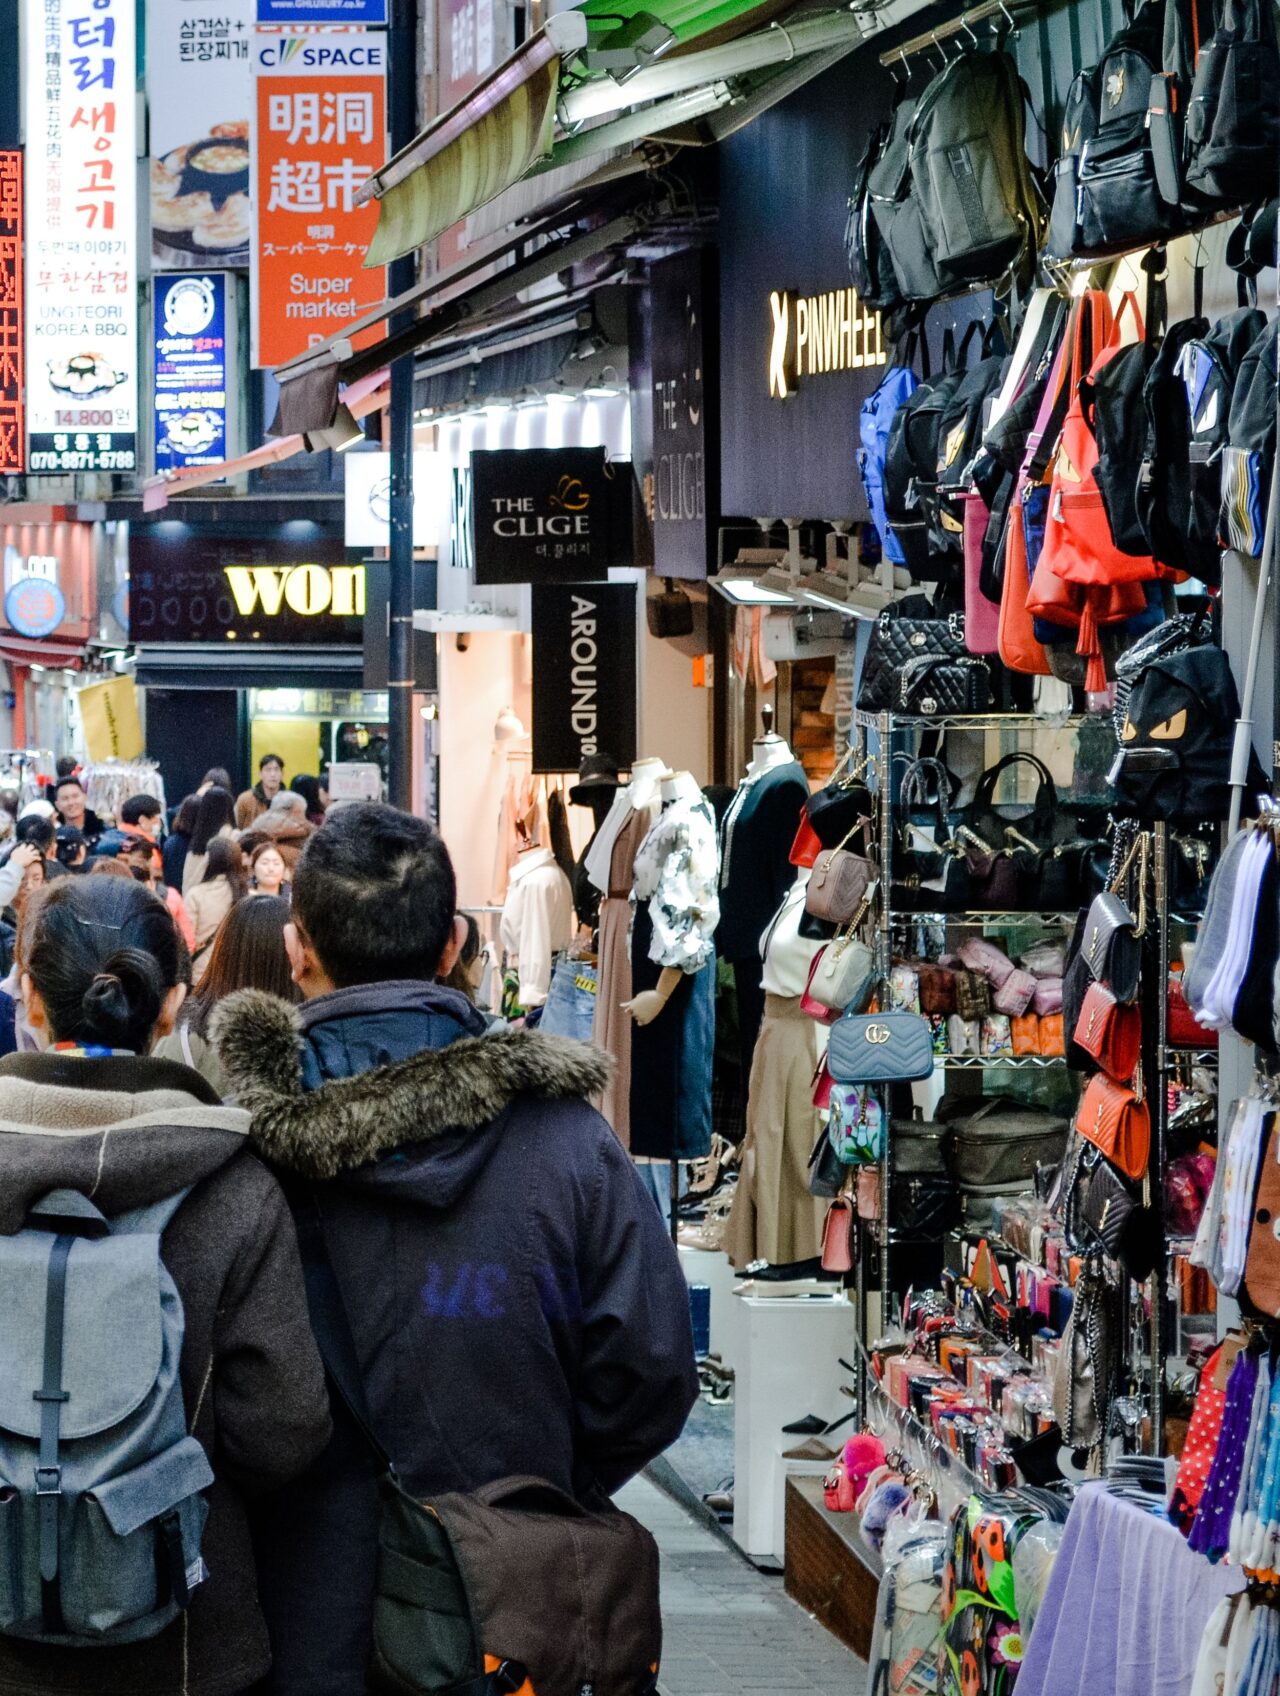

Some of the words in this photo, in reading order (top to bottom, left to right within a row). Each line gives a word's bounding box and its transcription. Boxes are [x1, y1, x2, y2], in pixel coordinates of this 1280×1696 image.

[180, 18, 230, 38] 삼겹살
[180, 40, 248, 61] 된장찌개
[303, 48, 381, 66] SPACE
[269, 92, 374, 145] 明洞
[267, 158, 374, 213] 超市
[263, 242, 370, 256] スーパーマーケッ
[290, 273, 352, 296] Super
[286, 298, 357, 318] market
[35, 324, 89, 336] KOREA
[95, 323, 128, 336] BBQ
[491, 498, 535, 513] THE
[493, 515, 590, 537] CLIGE
[224, 564, 366, 616] won
[570, 595, 598, 760] AROUND10
